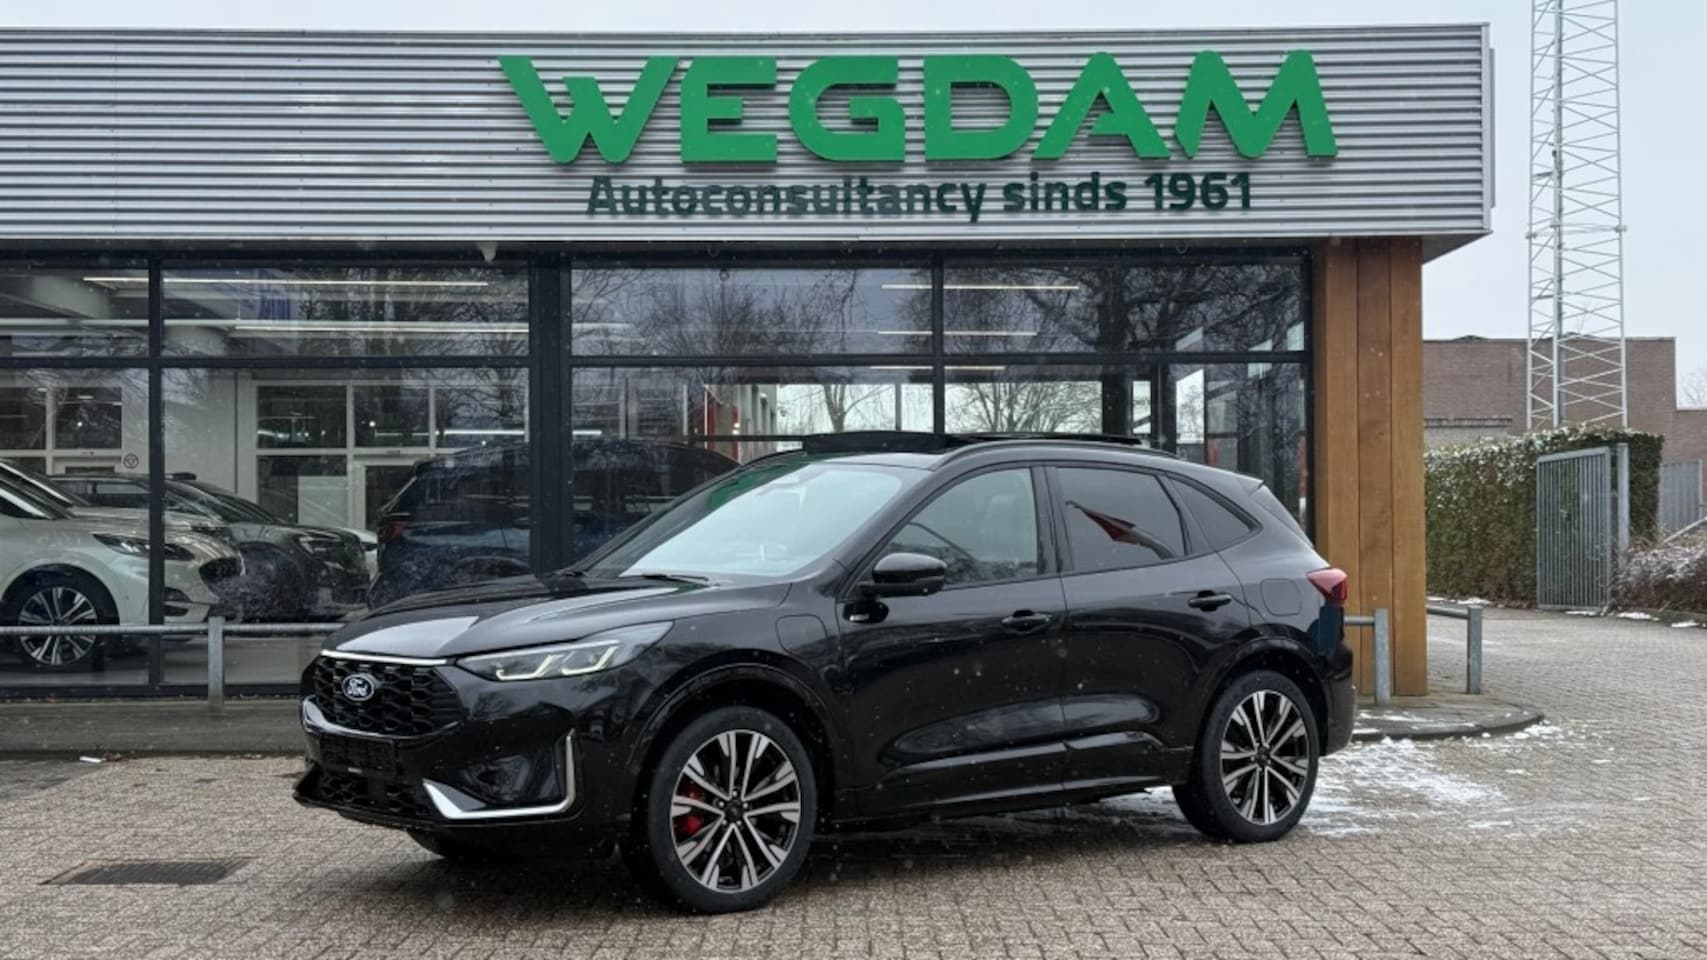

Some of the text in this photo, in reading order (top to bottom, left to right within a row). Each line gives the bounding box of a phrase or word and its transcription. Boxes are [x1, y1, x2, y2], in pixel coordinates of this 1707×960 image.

[499, 50, 1339, 165] WEGDAM
[587, 171, 1250, 223] Autoconsultancy sinds 1961
